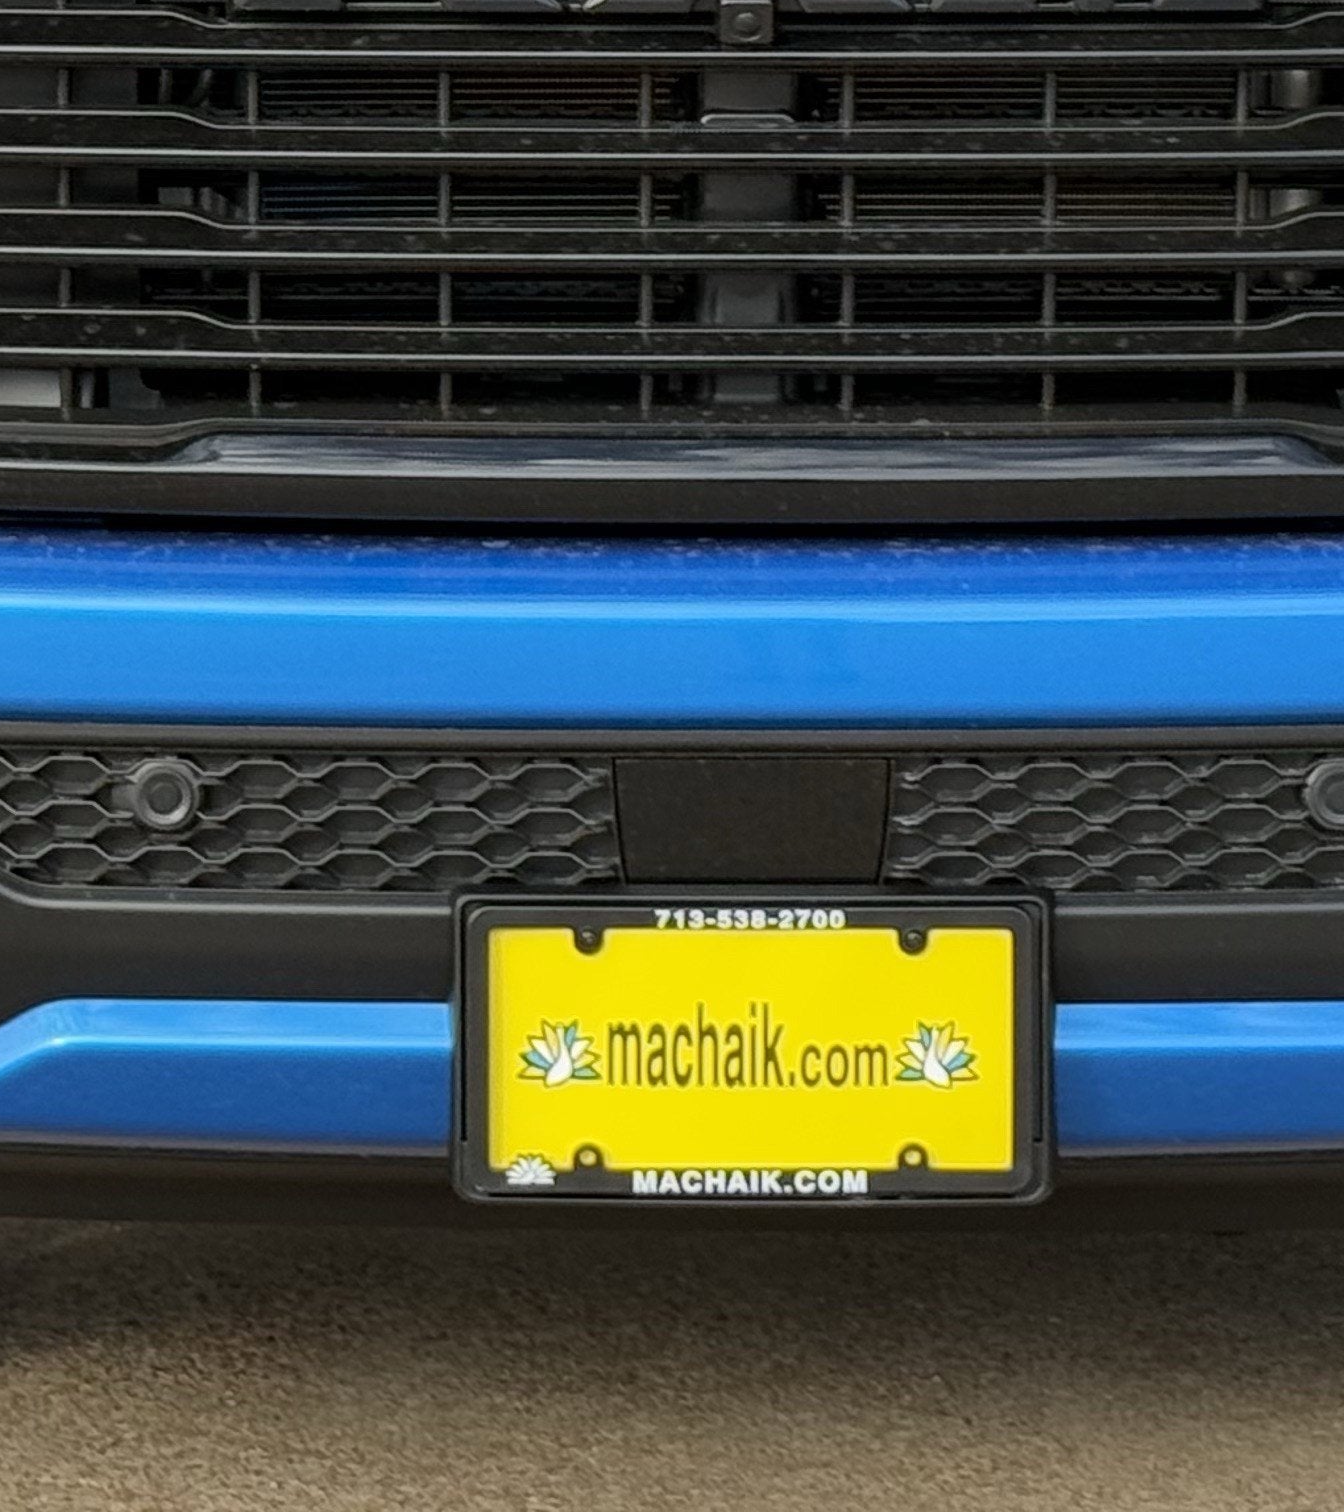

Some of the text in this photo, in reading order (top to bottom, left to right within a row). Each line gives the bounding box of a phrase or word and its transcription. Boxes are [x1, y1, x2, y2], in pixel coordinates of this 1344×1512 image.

[654, 908, 846, 929] 713-538-2700
[607, 1001, 889, 1088] machaik.com
[632, 1170, 868, 1194] MACHAIK.COM
